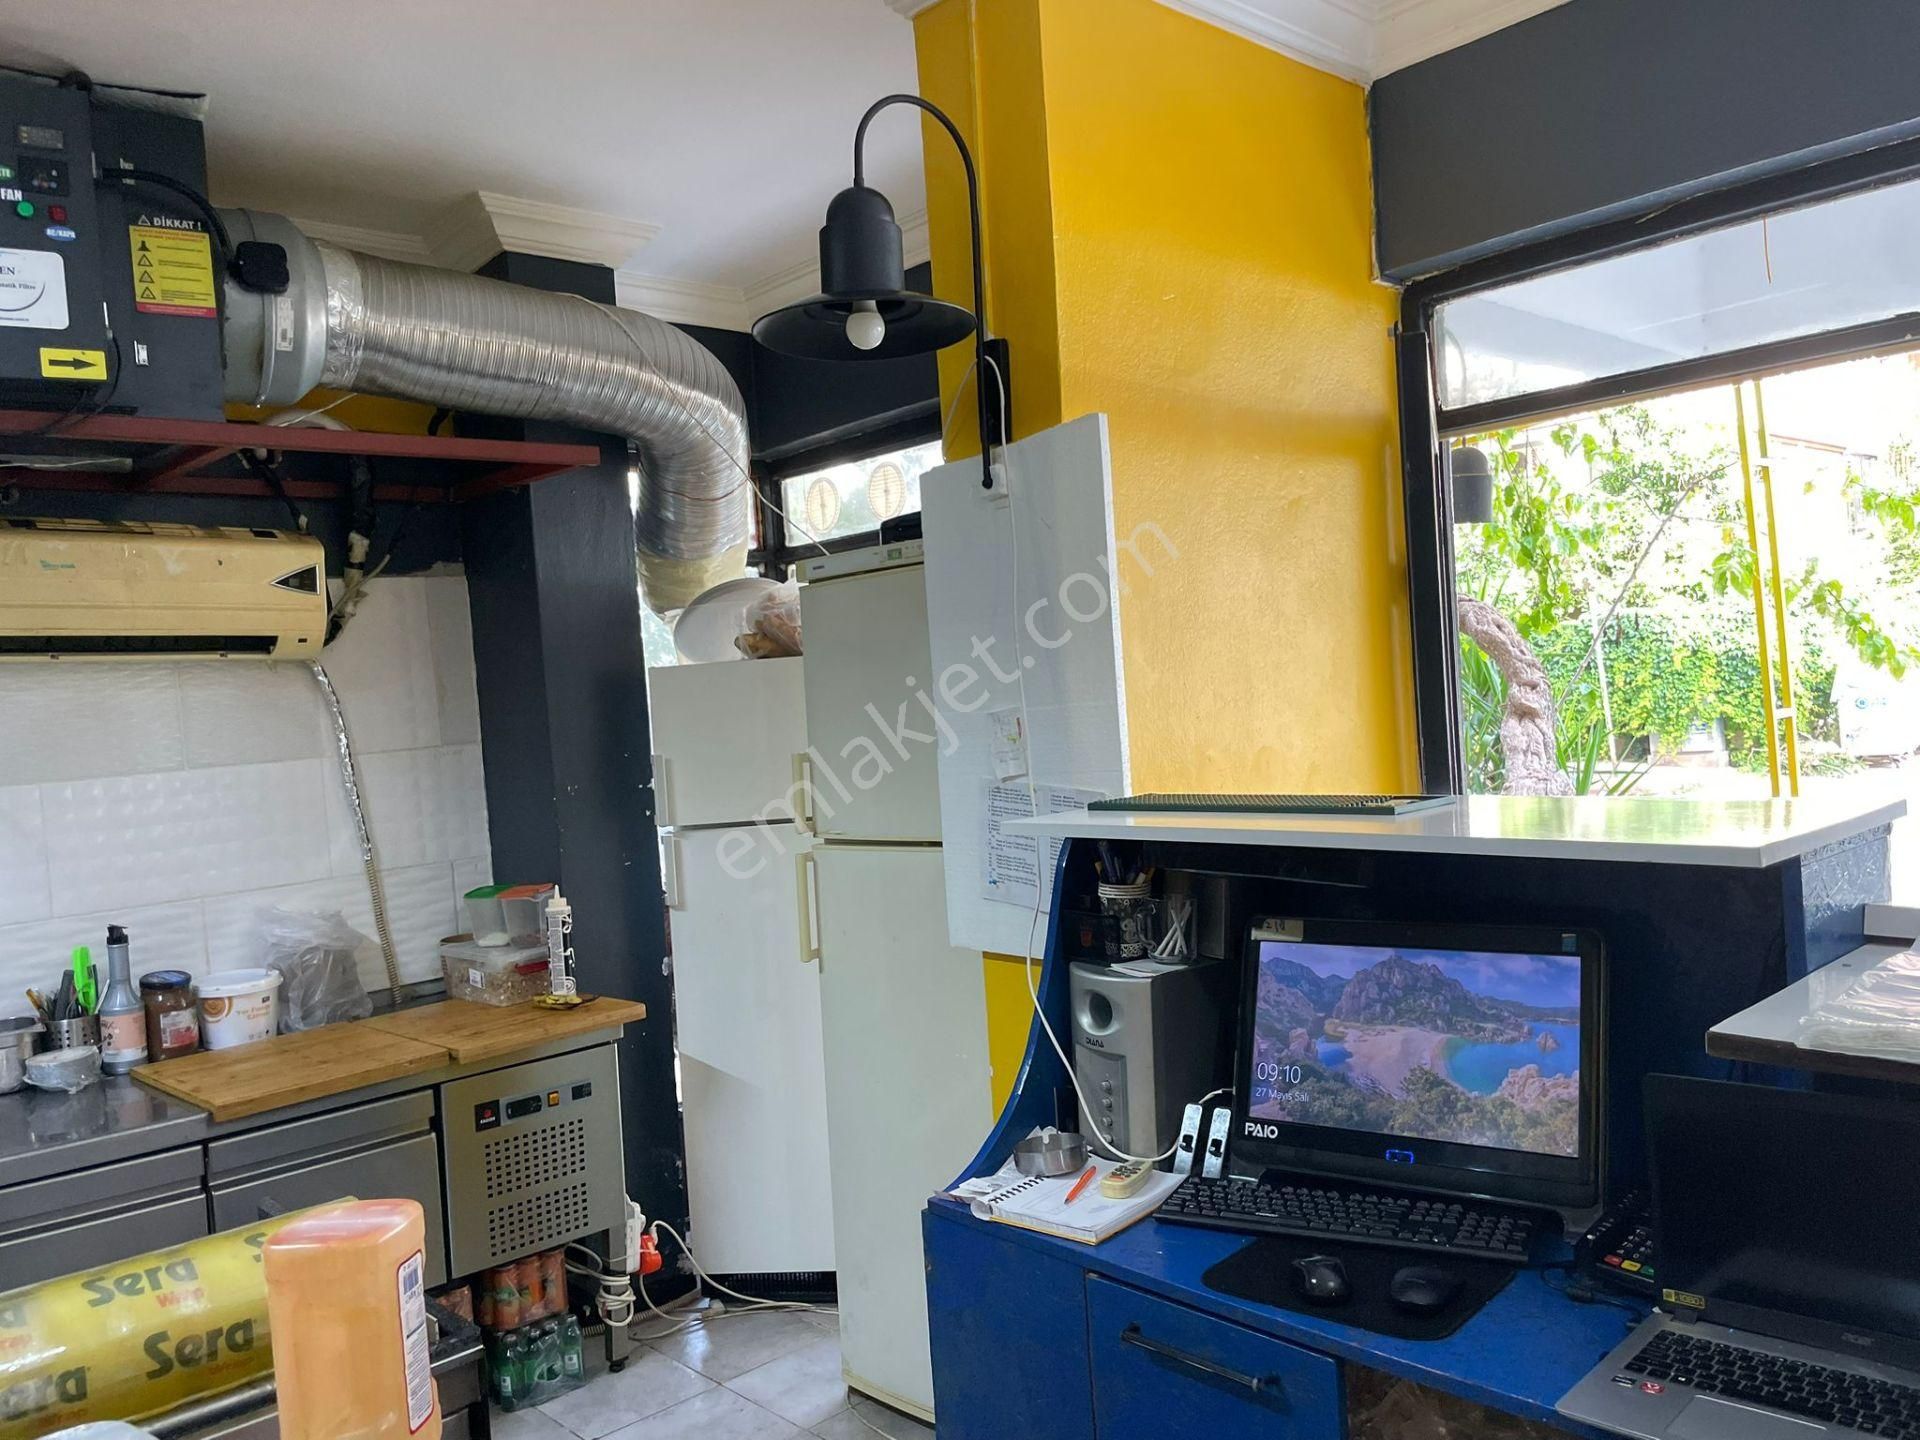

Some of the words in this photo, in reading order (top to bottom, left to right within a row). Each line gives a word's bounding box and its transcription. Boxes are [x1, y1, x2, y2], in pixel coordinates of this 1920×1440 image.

[0, 187, 23, 202] FAN
[153, 215, 195, 230] DİKKAT
[1257, 1062, 1302, 1084] 09:10
[1255, 1087, 1267, 1097] 27
[1268, 1089, 1293, 1102] Mayıs
[1294, 1091, 1309, 1102] Salı
[1244, 1122, 1279, 1139] PAIO
[81, 1257, 199, 1308] Sera
[143, 1317, 256, 1380] Sera
